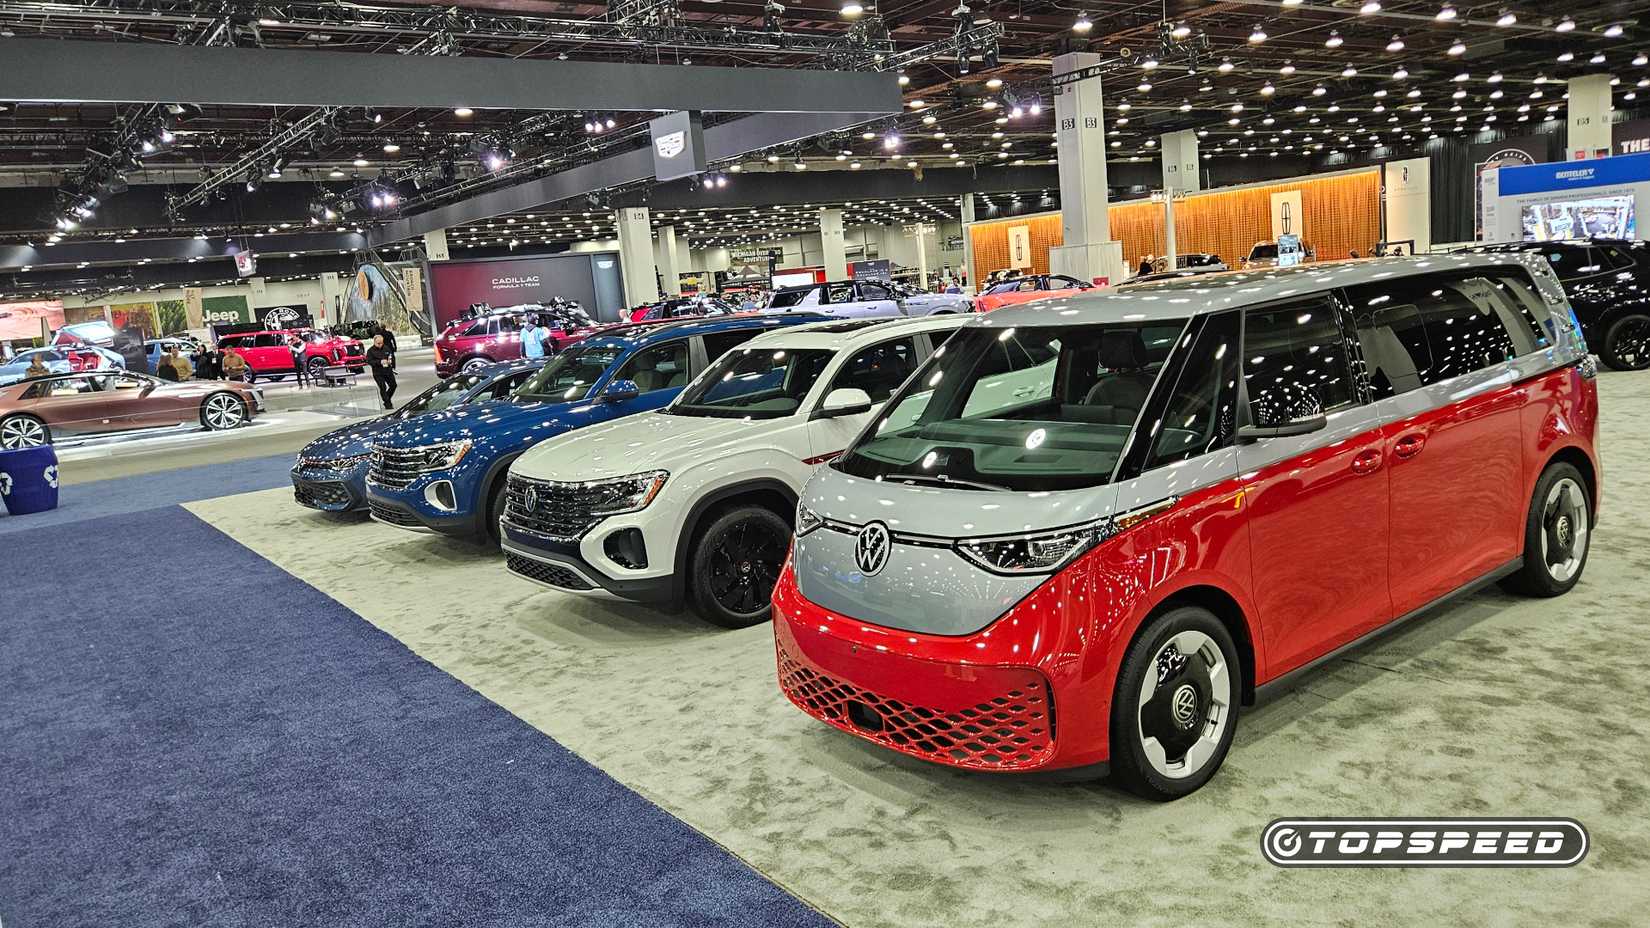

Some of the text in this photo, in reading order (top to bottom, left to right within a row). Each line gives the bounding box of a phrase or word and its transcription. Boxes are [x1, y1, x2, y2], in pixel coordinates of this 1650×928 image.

[1063, 119, 1073, 130] B3
[1086, 117, 1096, 128] B3
[1621, 139, 1650, 154] THE
[492, 275, 540, 285] CADILLAC
[203, 309, 239, 322] Jeep
